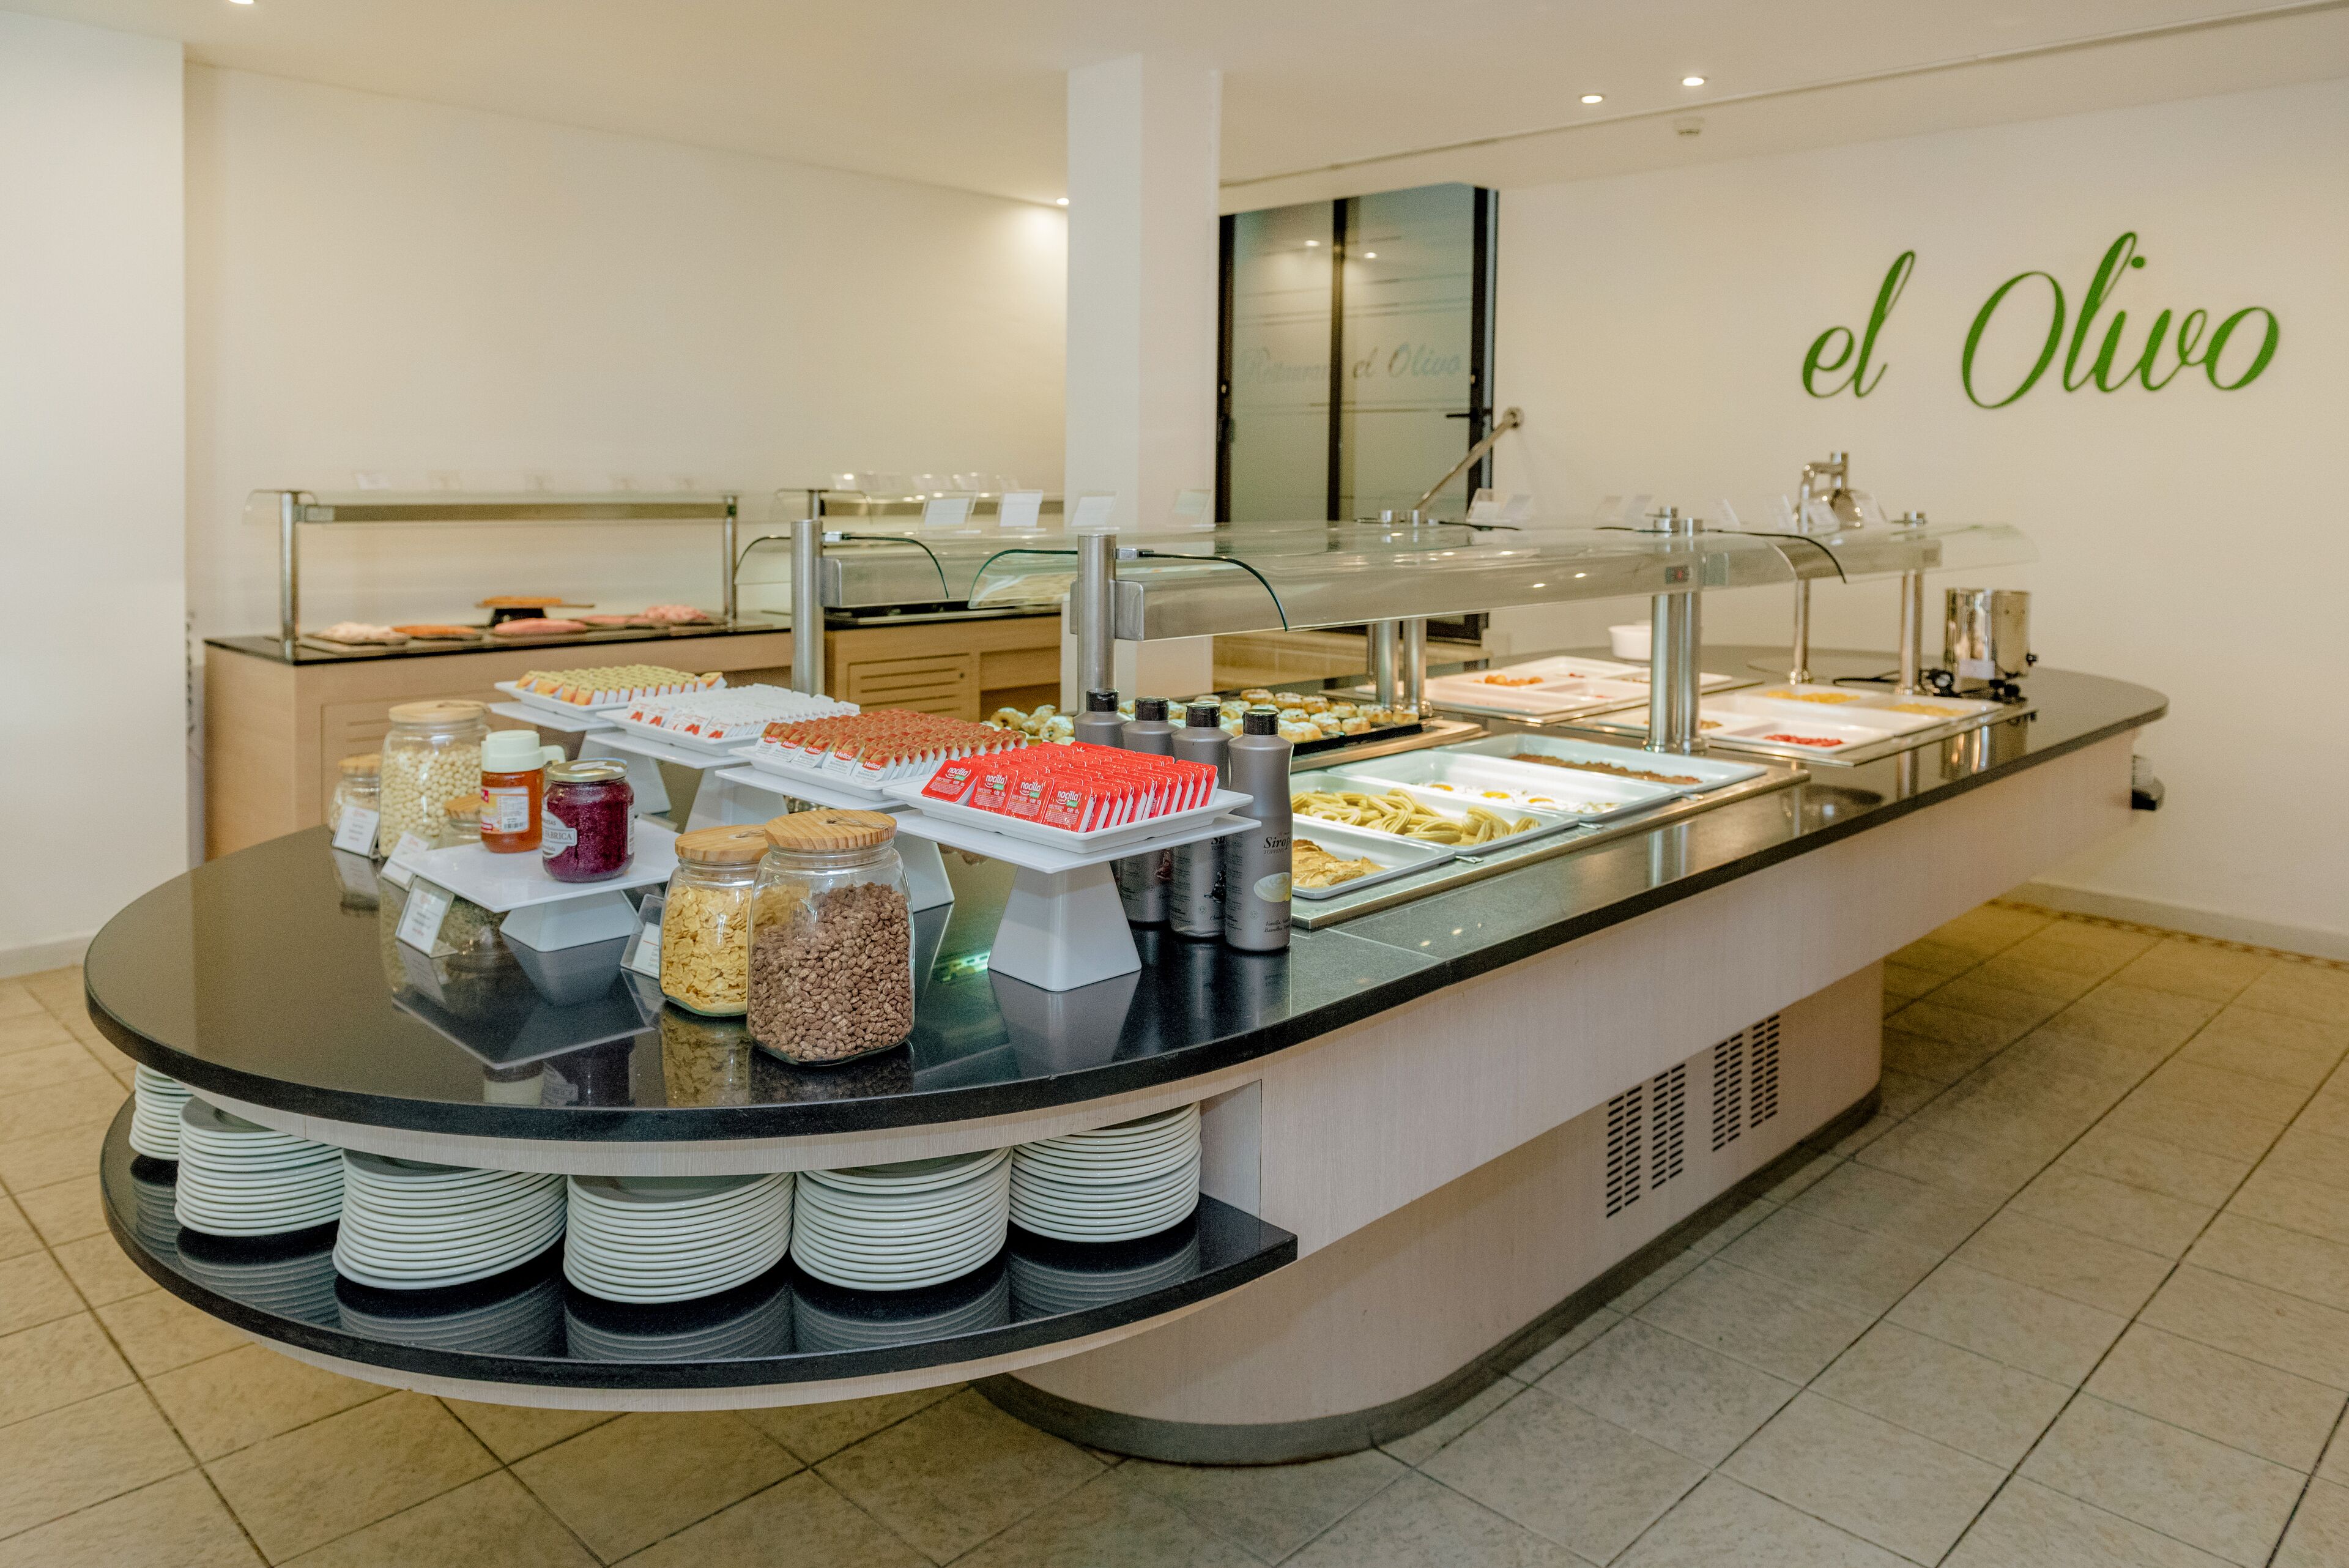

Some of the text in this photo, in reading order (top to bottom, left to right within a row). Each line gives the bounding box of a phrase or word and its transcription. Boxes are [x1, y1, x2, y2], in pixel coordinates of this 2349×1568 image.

[1802, 231, 2279, 409] el Olivo
[836, 751, 852, 760] Helios
[864, 761, 881, 770] Helios
[948, 767, 968, 776] nocilla
[985, 774, 1005, 784] nocilla
[1021, 781, 1041, 792] nocilla
[1057, 790, 1078, 801] nocilla
